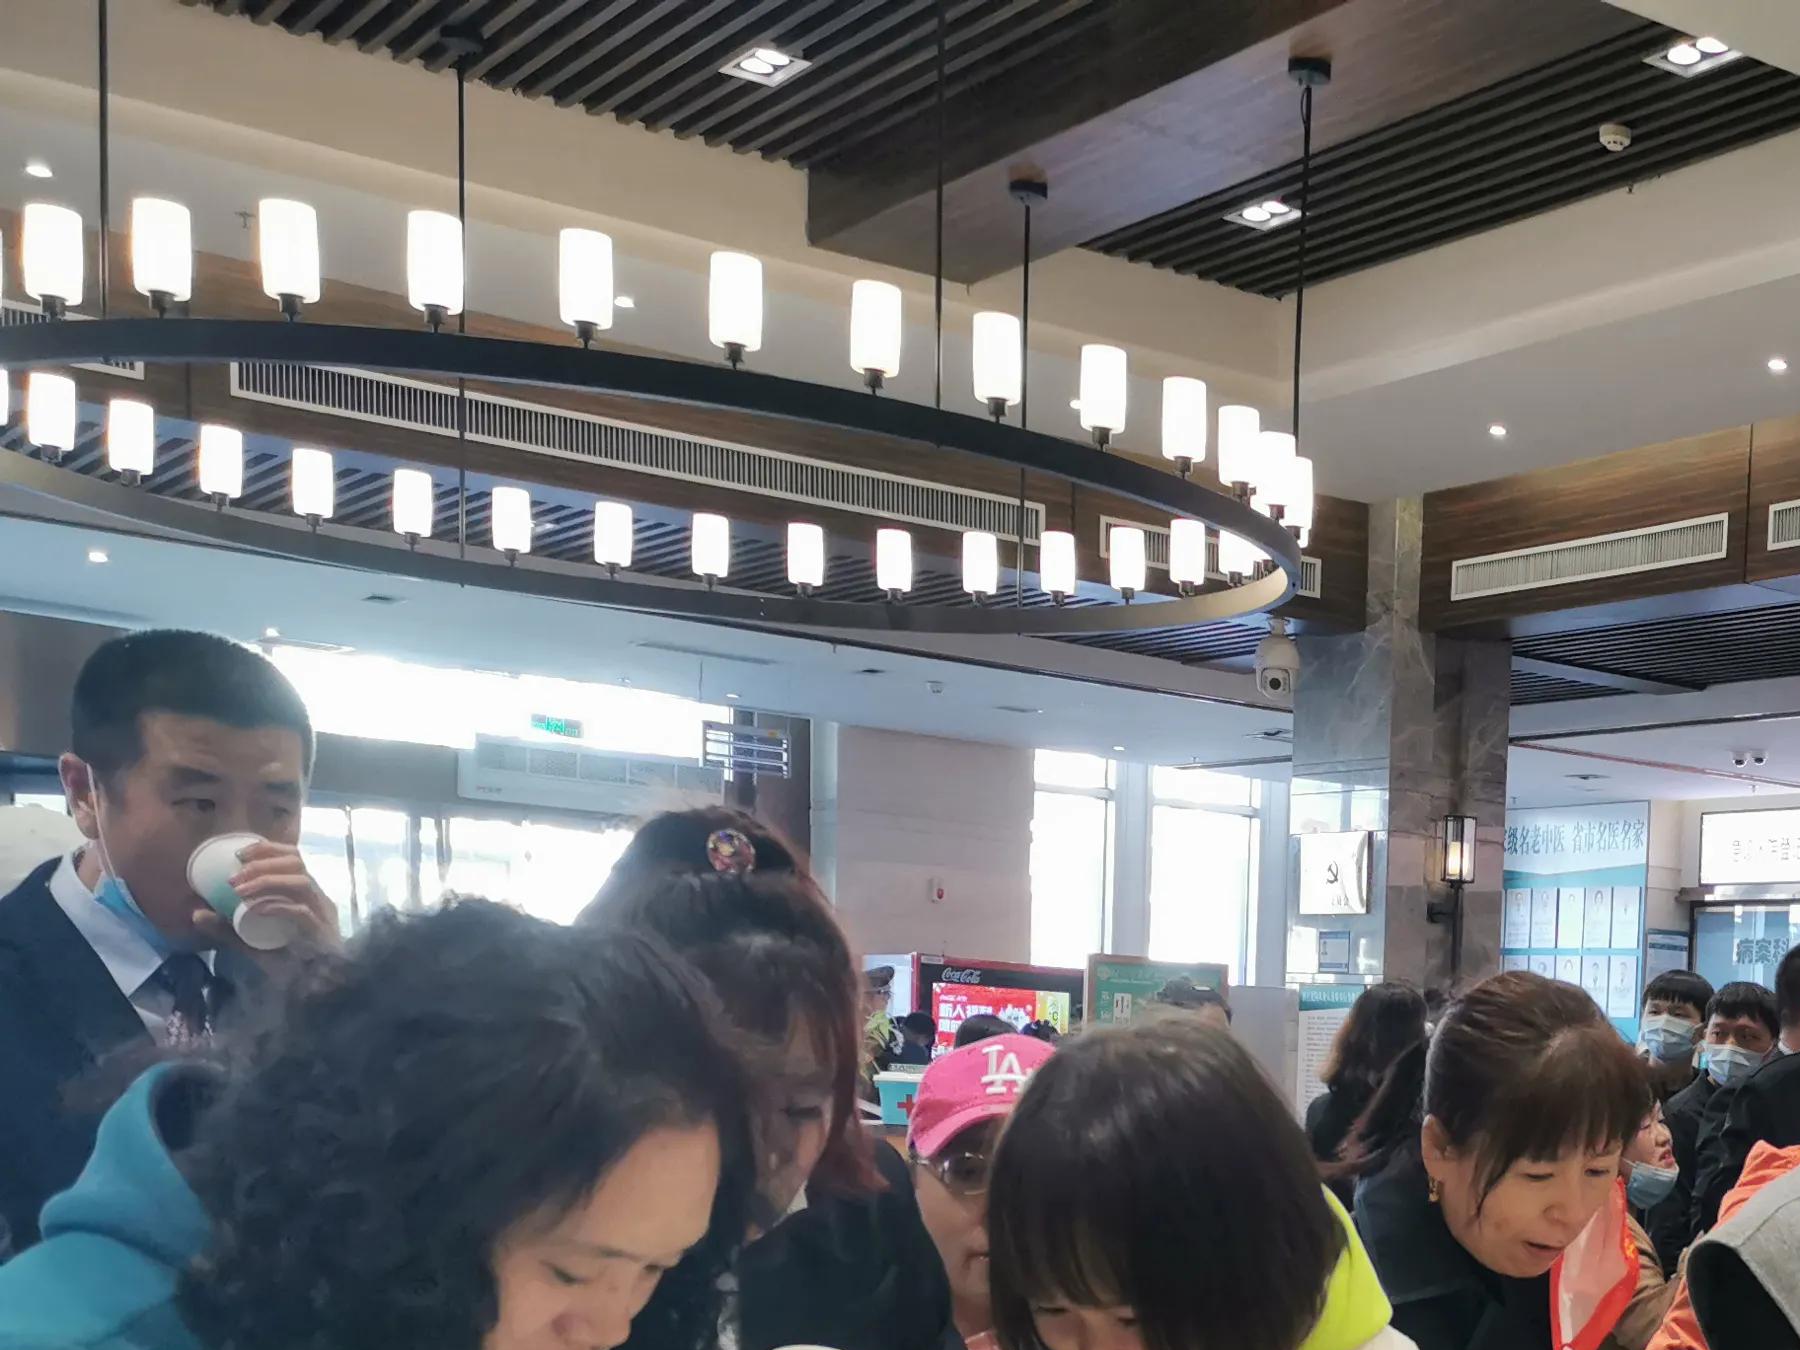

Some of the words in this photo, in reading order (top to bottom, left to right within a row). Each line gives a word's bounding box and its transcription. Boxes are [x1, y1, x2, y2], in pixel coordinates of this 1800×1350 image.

[1503, 823, 1565, 855] 级名老中医
[1572, 818, 1645, 854] 省市名医名家
[981, 1044, 1033, 1094] LA
